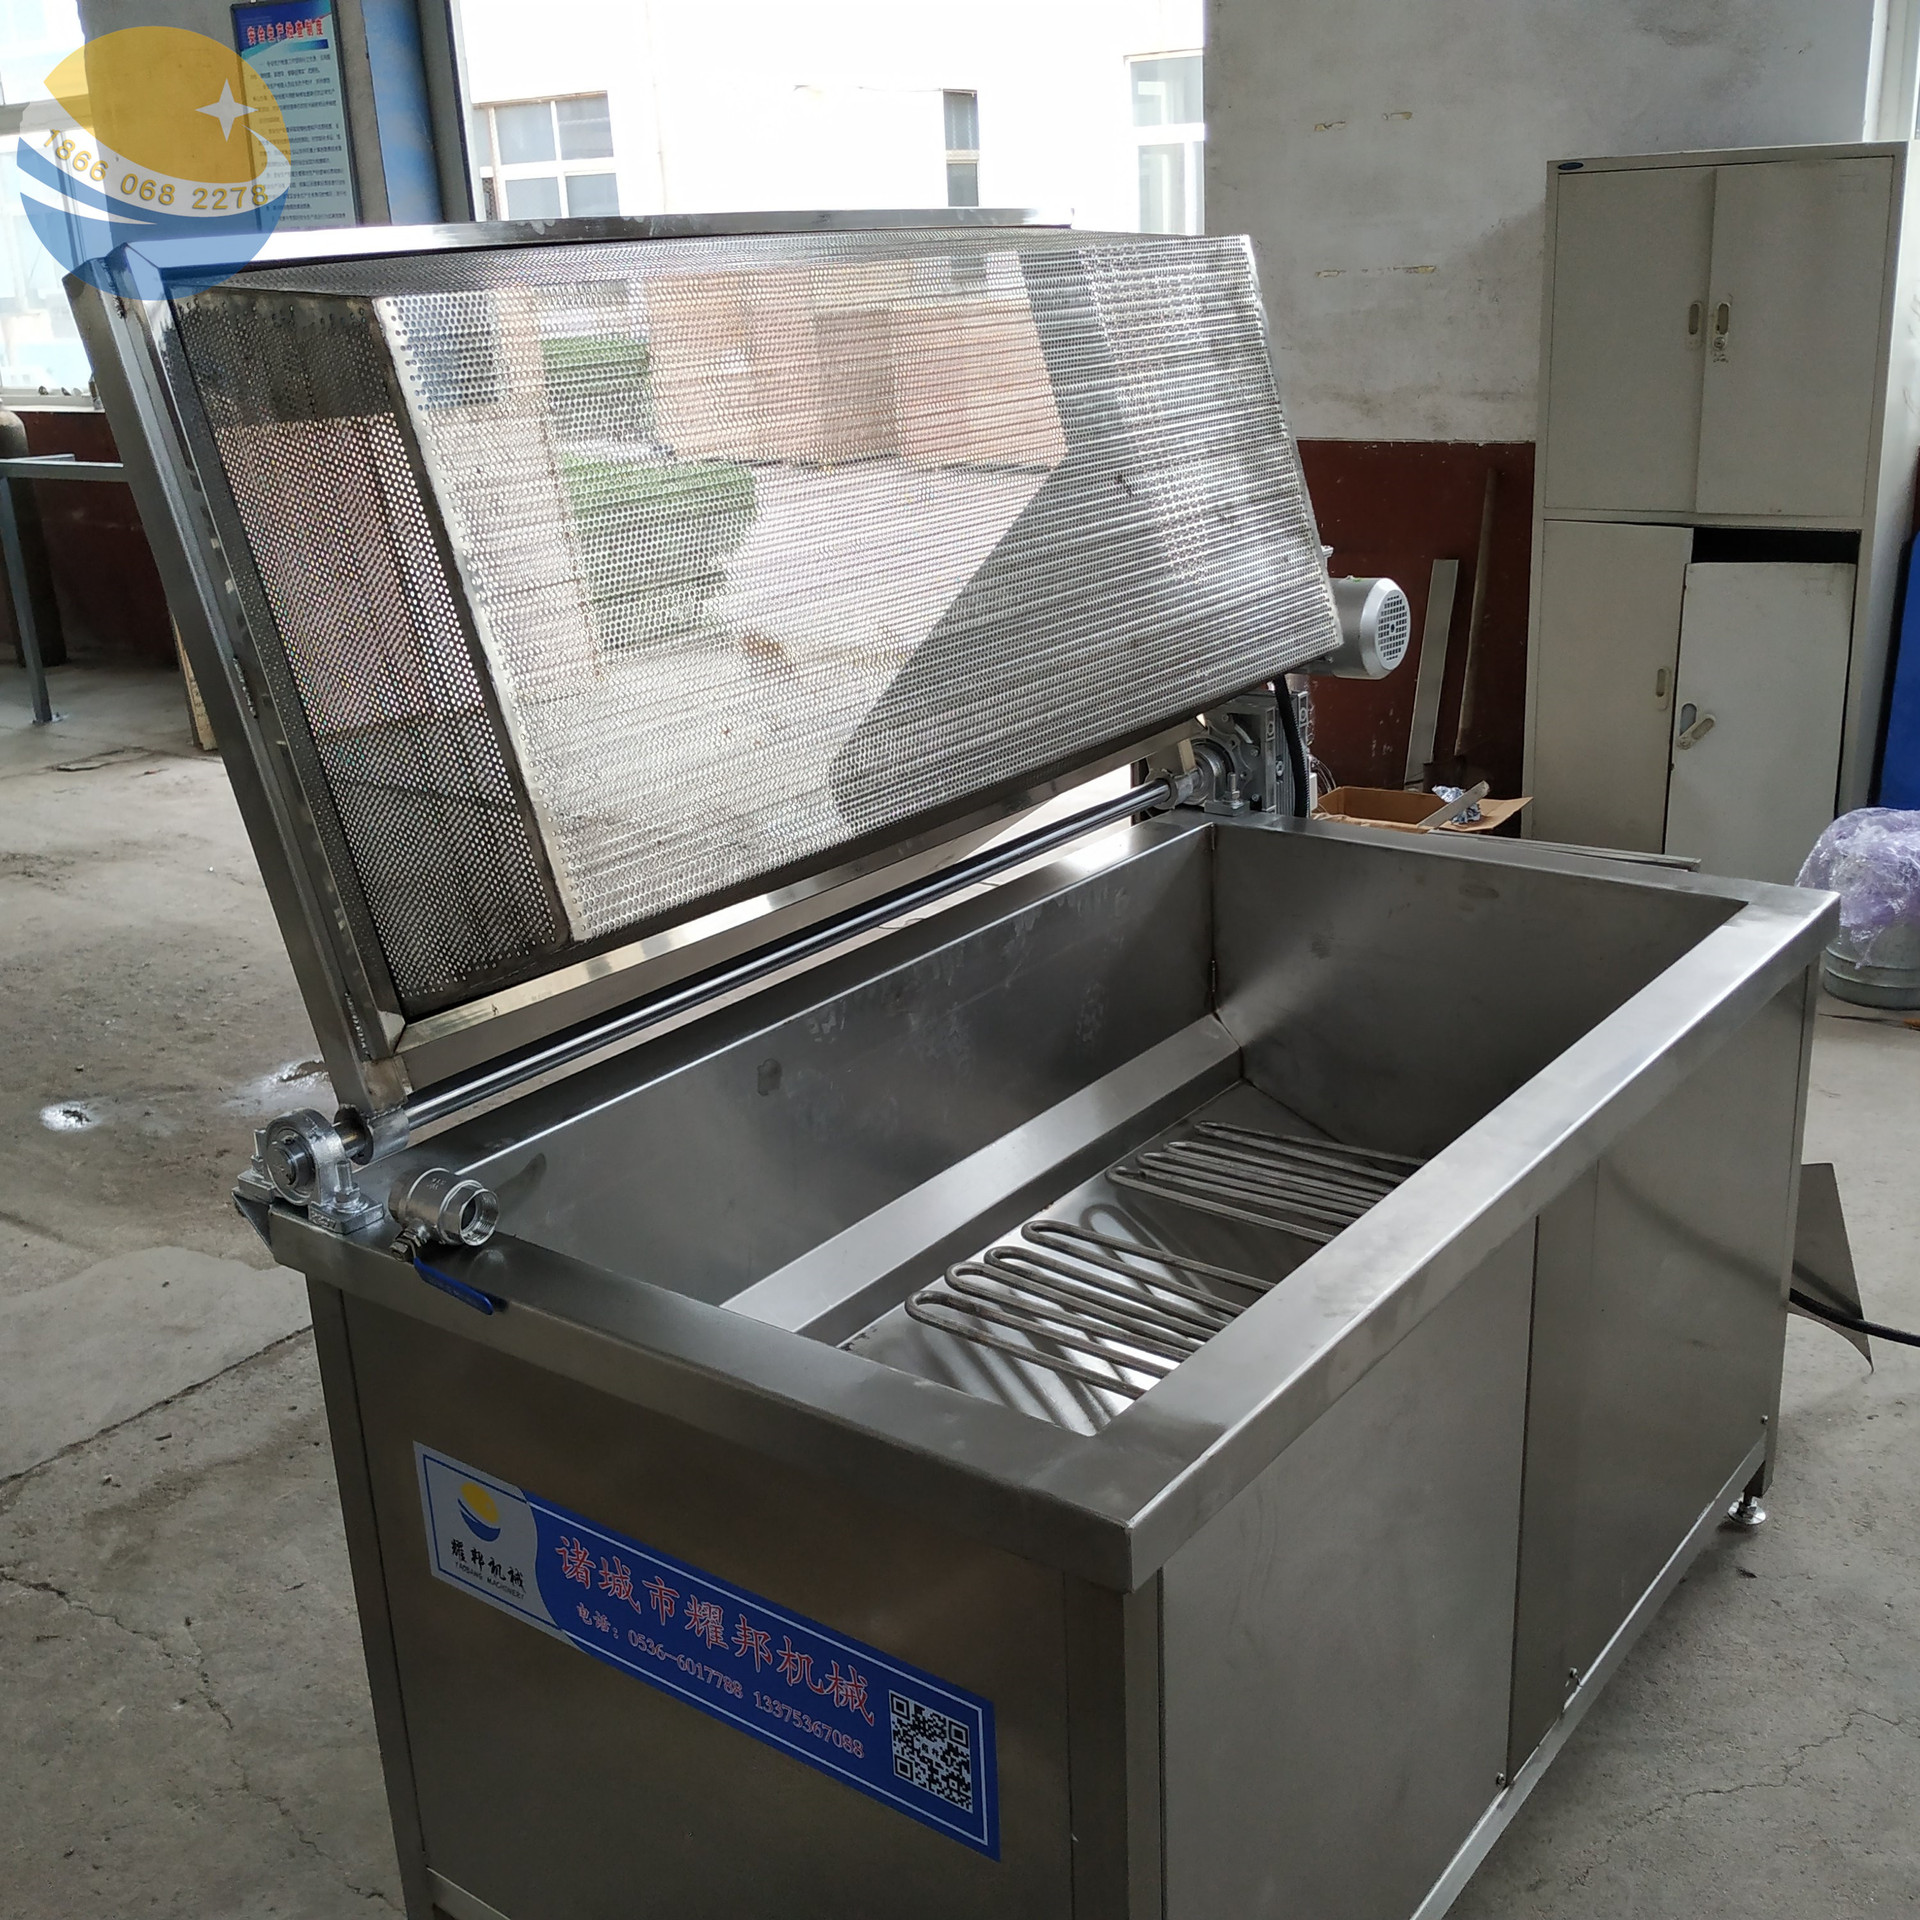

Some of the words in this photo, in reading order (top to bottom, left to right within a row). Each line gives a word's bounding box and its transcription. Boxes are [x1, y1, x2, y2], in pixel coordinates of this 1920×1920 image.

[555, 1535, 875, 1727] 诸城市耀邦机械
[753, 1690, 865, 1759] 13375367088
